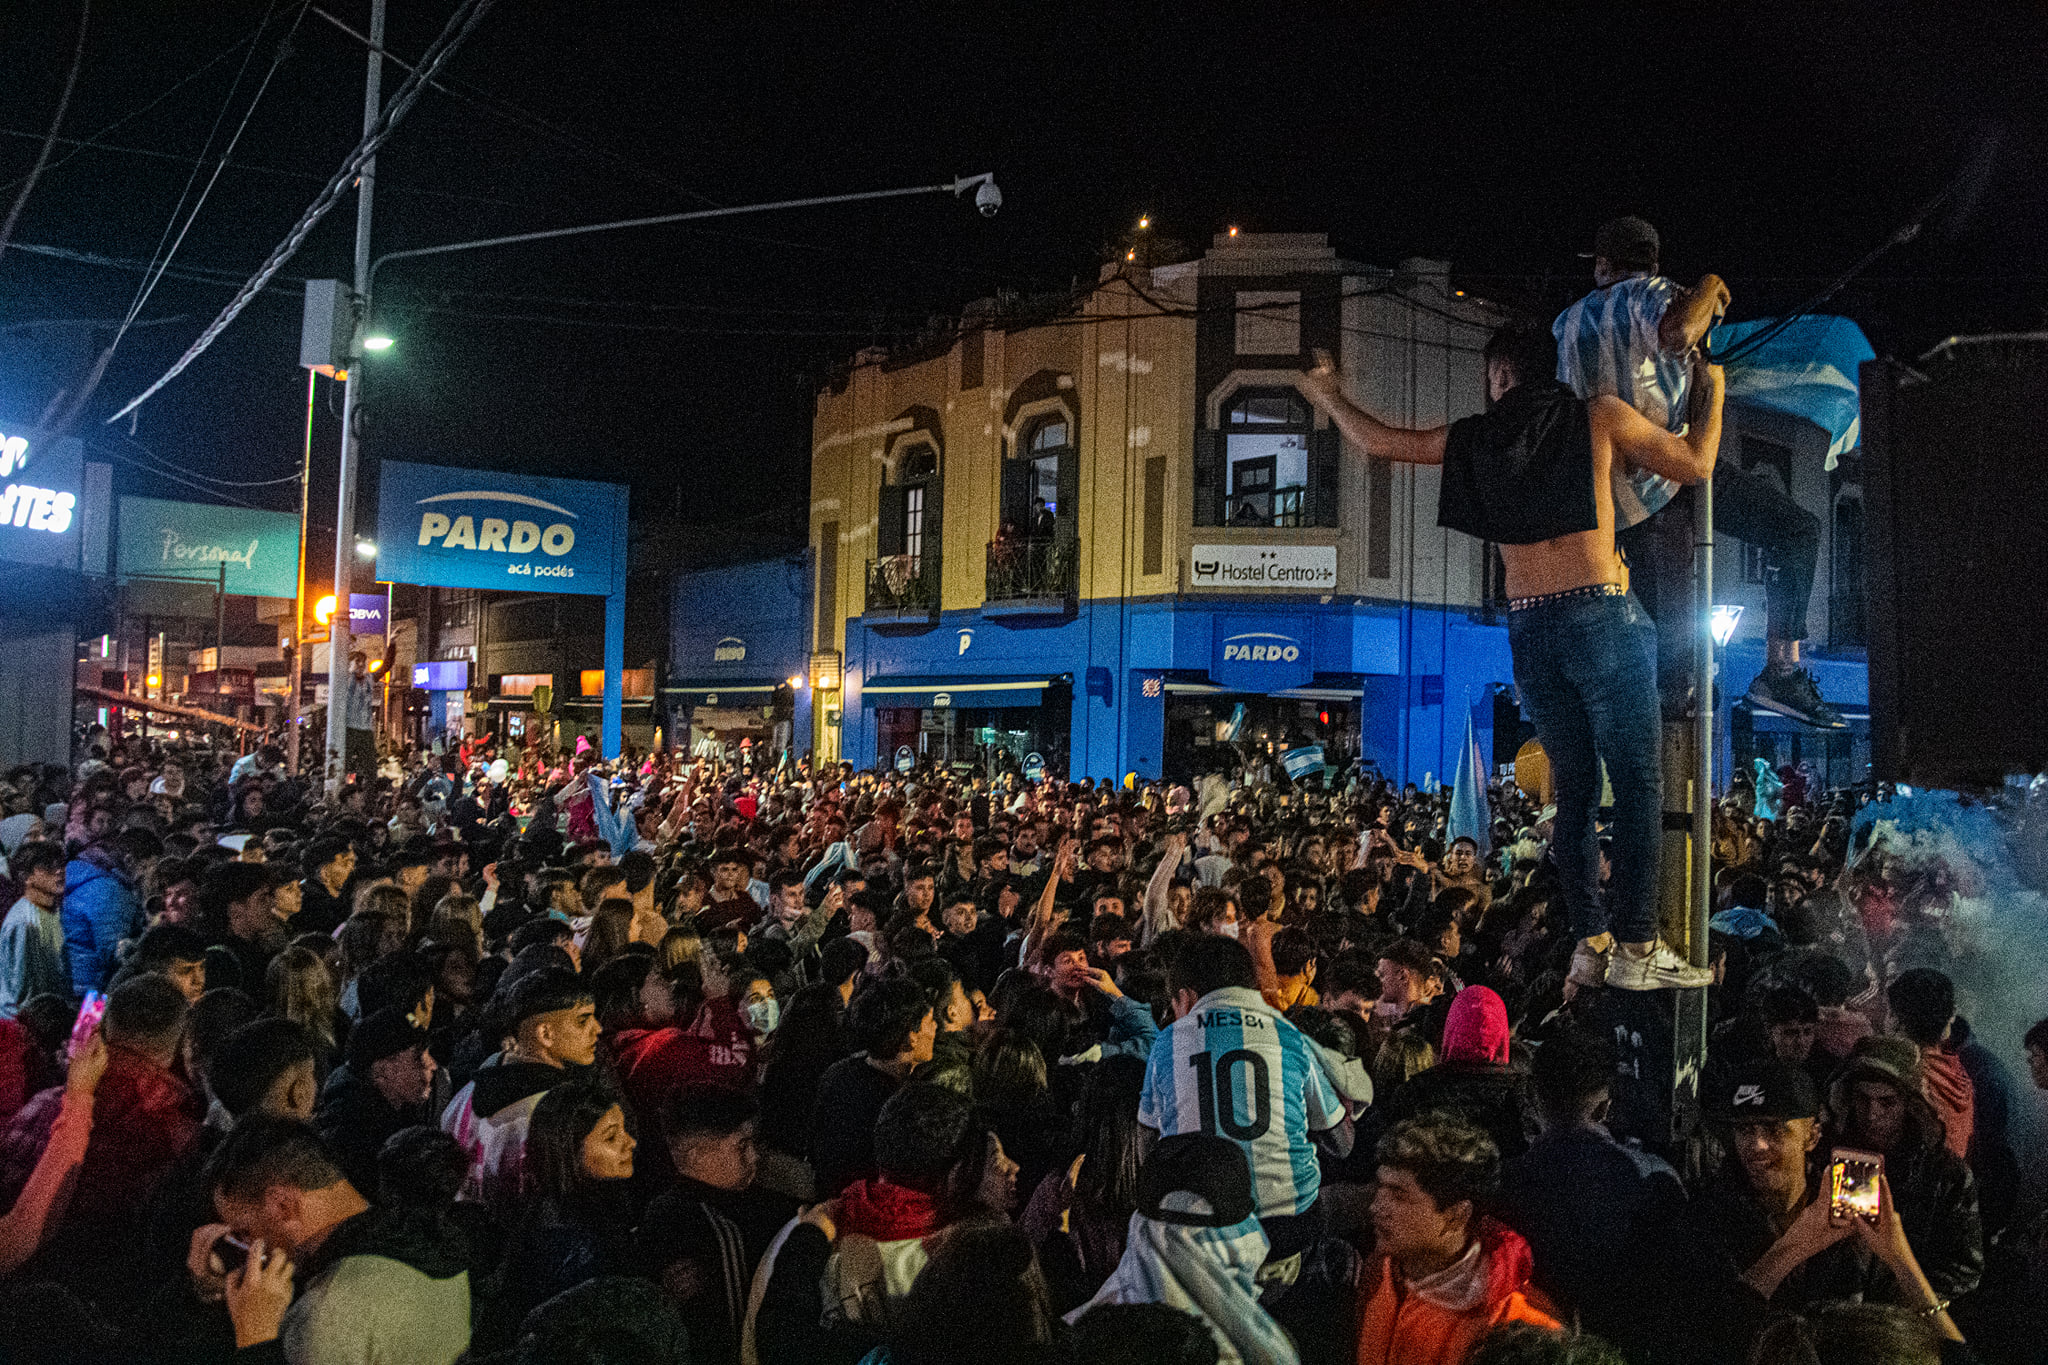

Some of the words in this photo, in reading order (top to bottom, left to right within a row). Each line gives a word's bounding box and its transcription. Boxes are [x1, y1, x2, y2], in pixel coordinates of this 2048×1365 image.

[418, 512, 575, 556] PARDO
[161, 528, 259, 570] Personal
[507, 563, 531, 575] acá
[534, 565, 575, 578] podés
[1222, 564, 1265, 580] Hostel
[1268, 564, 1315, 581] Centro
[1223, 645, 1299, 662] PARDO
[1189, 1049, 1271, 1141] 10
